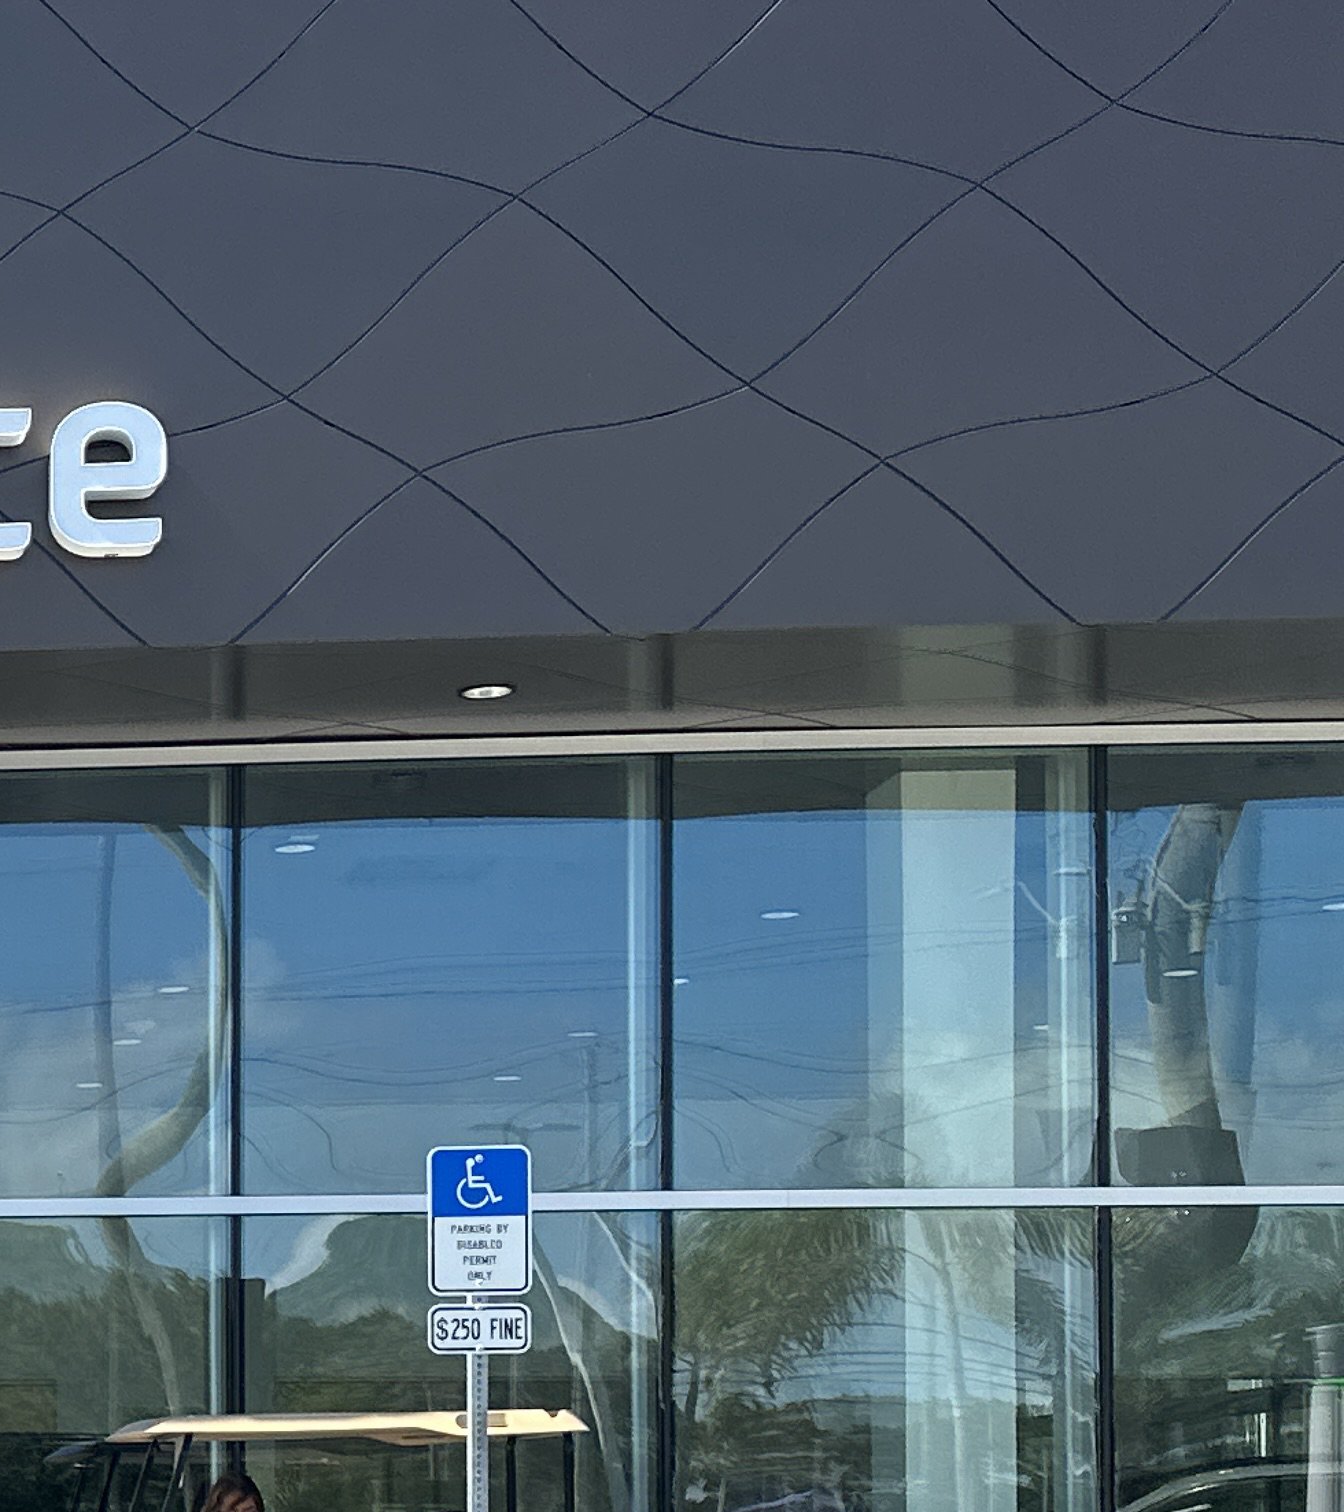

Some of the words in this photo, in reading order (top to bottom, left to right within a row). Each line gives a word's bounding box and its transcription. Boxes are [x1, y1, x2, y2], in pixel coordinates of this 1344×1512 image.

[450, 1224, 492, 1235] PARKING
[496, 1223, 510, 1234] BY
[462, 1256, 497, 1266] PERMIT
[435, 1317, 481, 1342] $250
[490, 1317, 524, 1340] FINE
